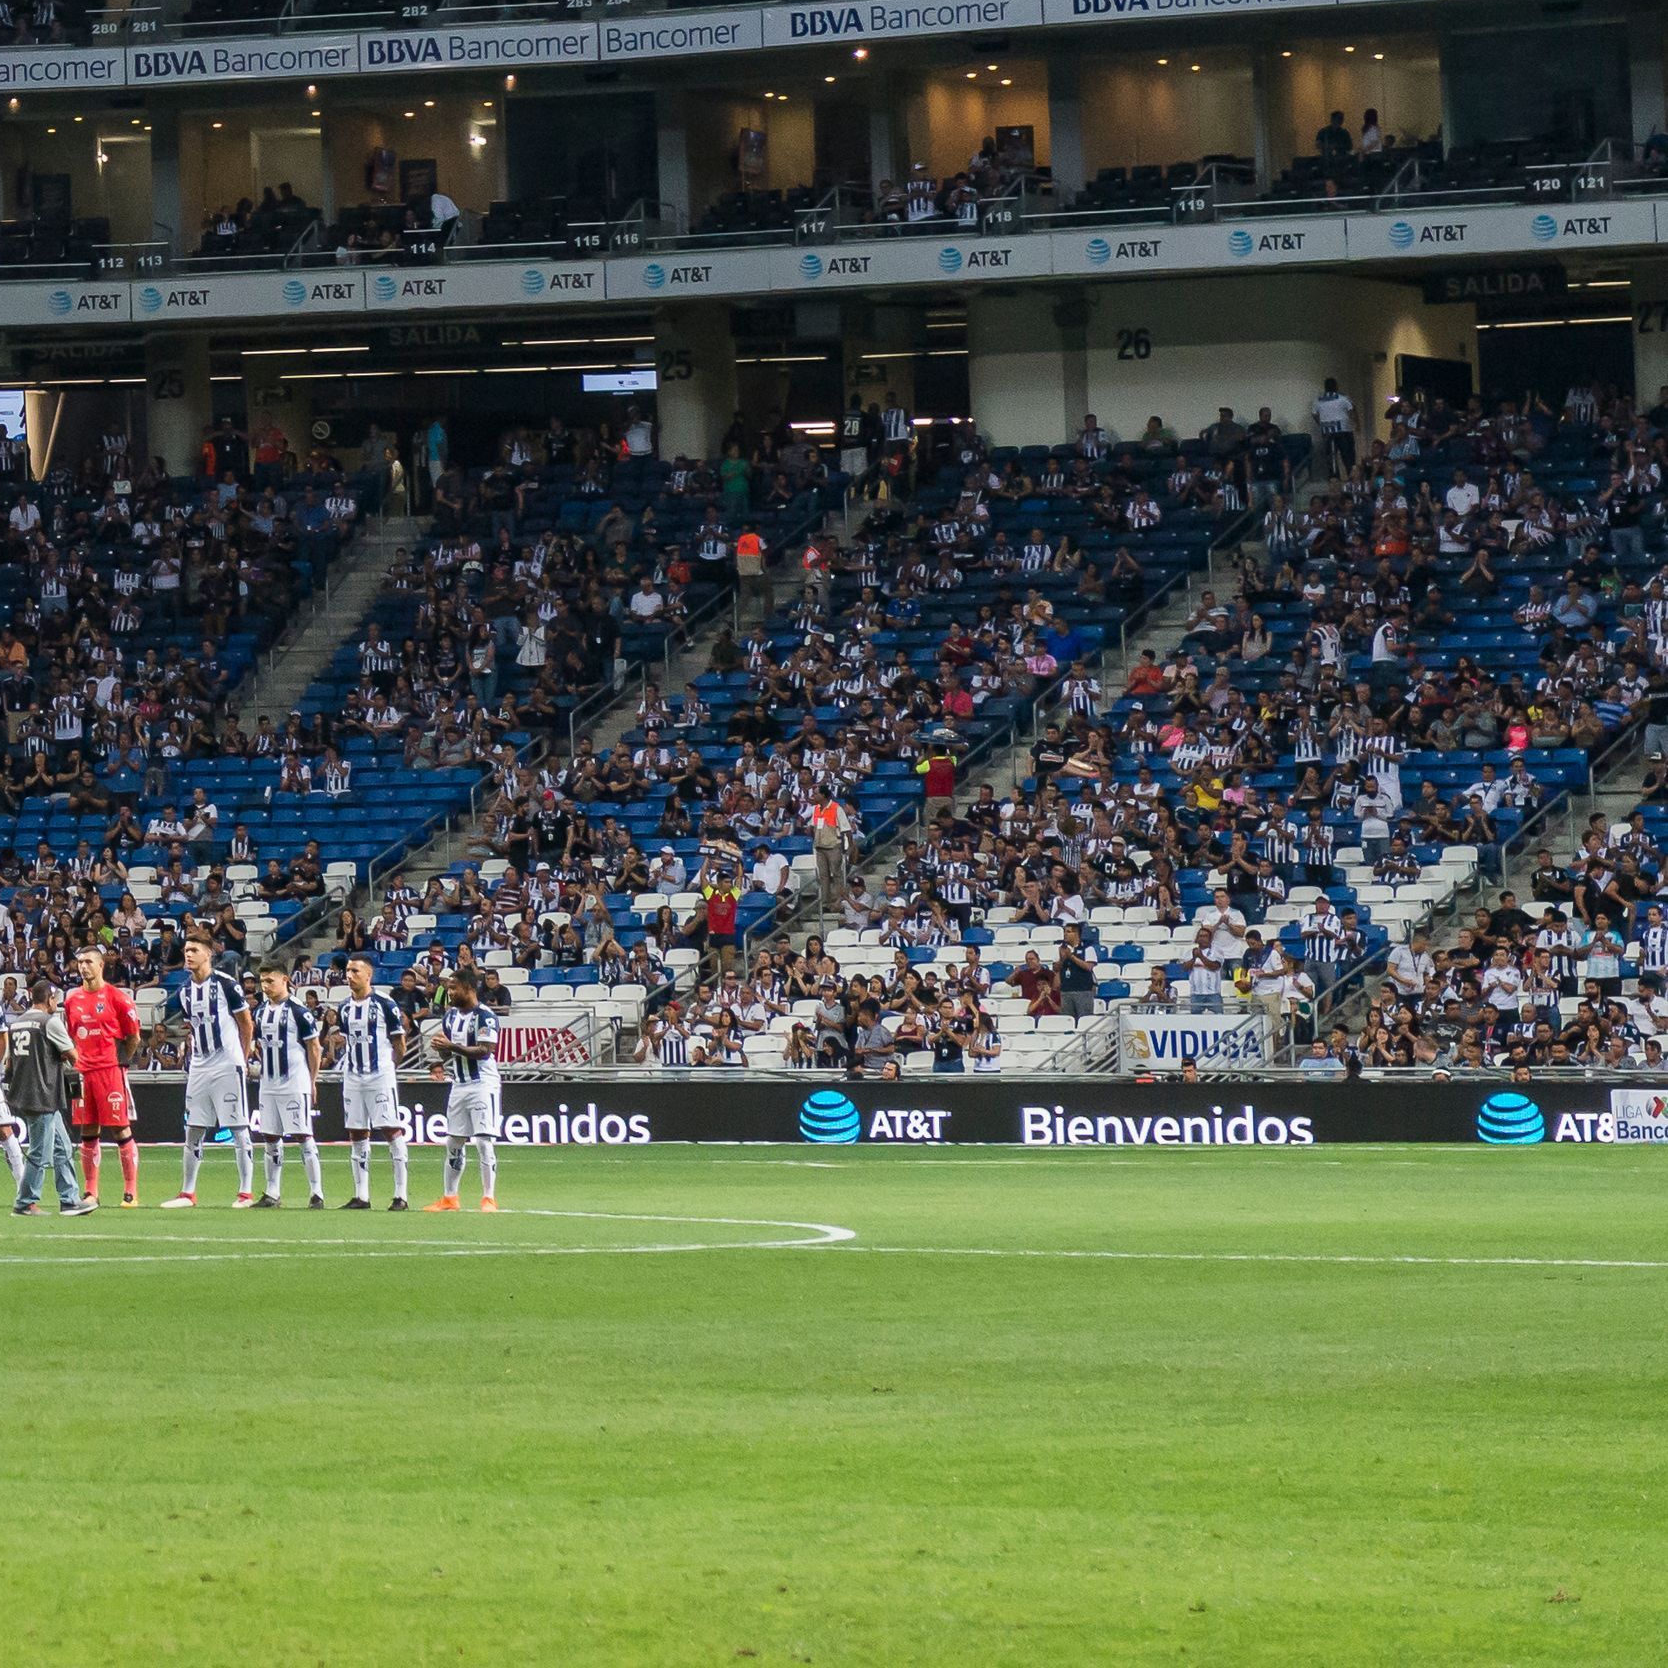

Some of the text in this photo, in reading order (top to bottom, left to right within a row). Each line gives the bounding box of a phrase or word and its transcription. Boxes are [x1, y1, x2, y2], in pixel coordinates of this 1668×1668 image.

[790, 1, 1009, 38] BBVA Bancomer
[606, 23, 741, 54] Bancomer
[134, 47, 351, 78] BBVA Bancomer
[1532, 178, 1561, 192] 120
[1419, 224, 1468, 243] AT&T
[410, 242, 437, 255] 114
[827, 256, 872, 274] AT&T
[166, 289, 211, 307] AT&T
[1117, 329, 1151, 360] 26
[12, 1031, 31, 1056] 32
[1150, 1029, 1262, 1059] VIDUSA
[869, 1105, 1314, 1144] AT&T Bienvenidos
[1616, 1105, 1643, 1120] LIGA
